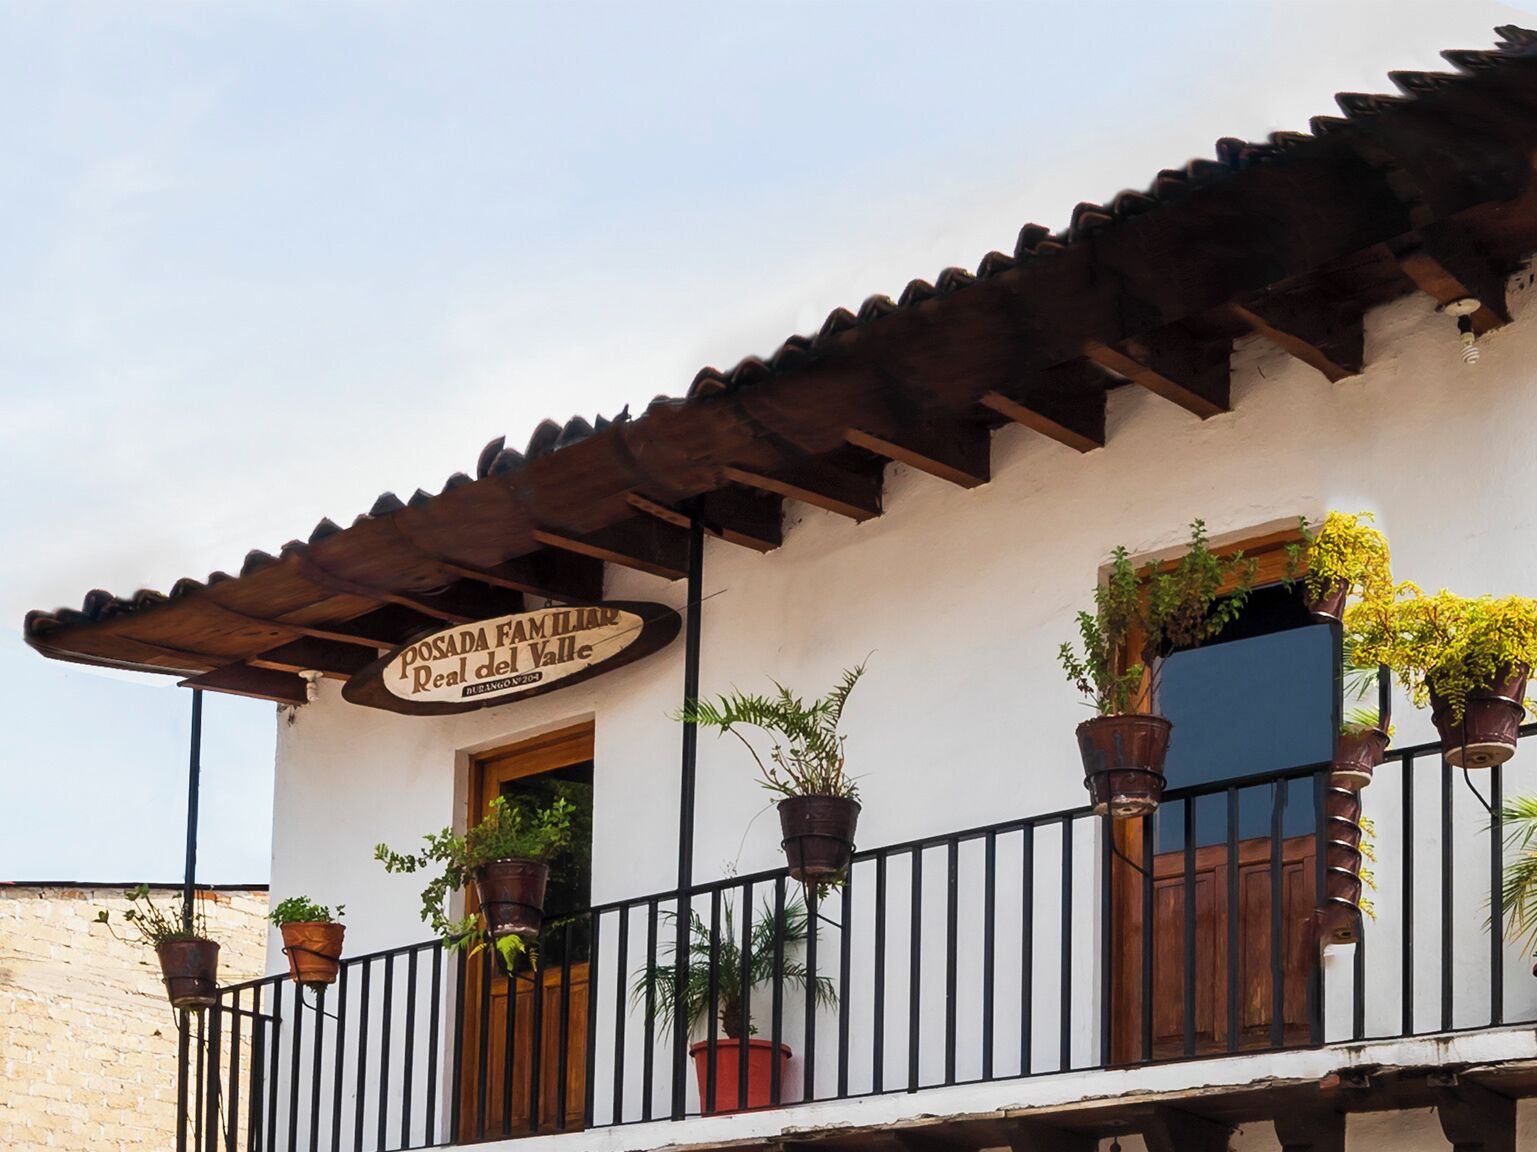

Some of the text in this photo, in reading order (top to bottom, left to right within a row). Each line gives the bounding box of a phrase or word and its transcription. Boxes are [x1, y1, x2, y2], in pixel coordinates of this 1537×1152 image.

[399, 607, 619, 680] POSADA FAMILIAR
[411, 635, 593, 694] Real del Valle
[466, 679, 511, 695] DURANGO
[522, 673, 540, 683] 204
